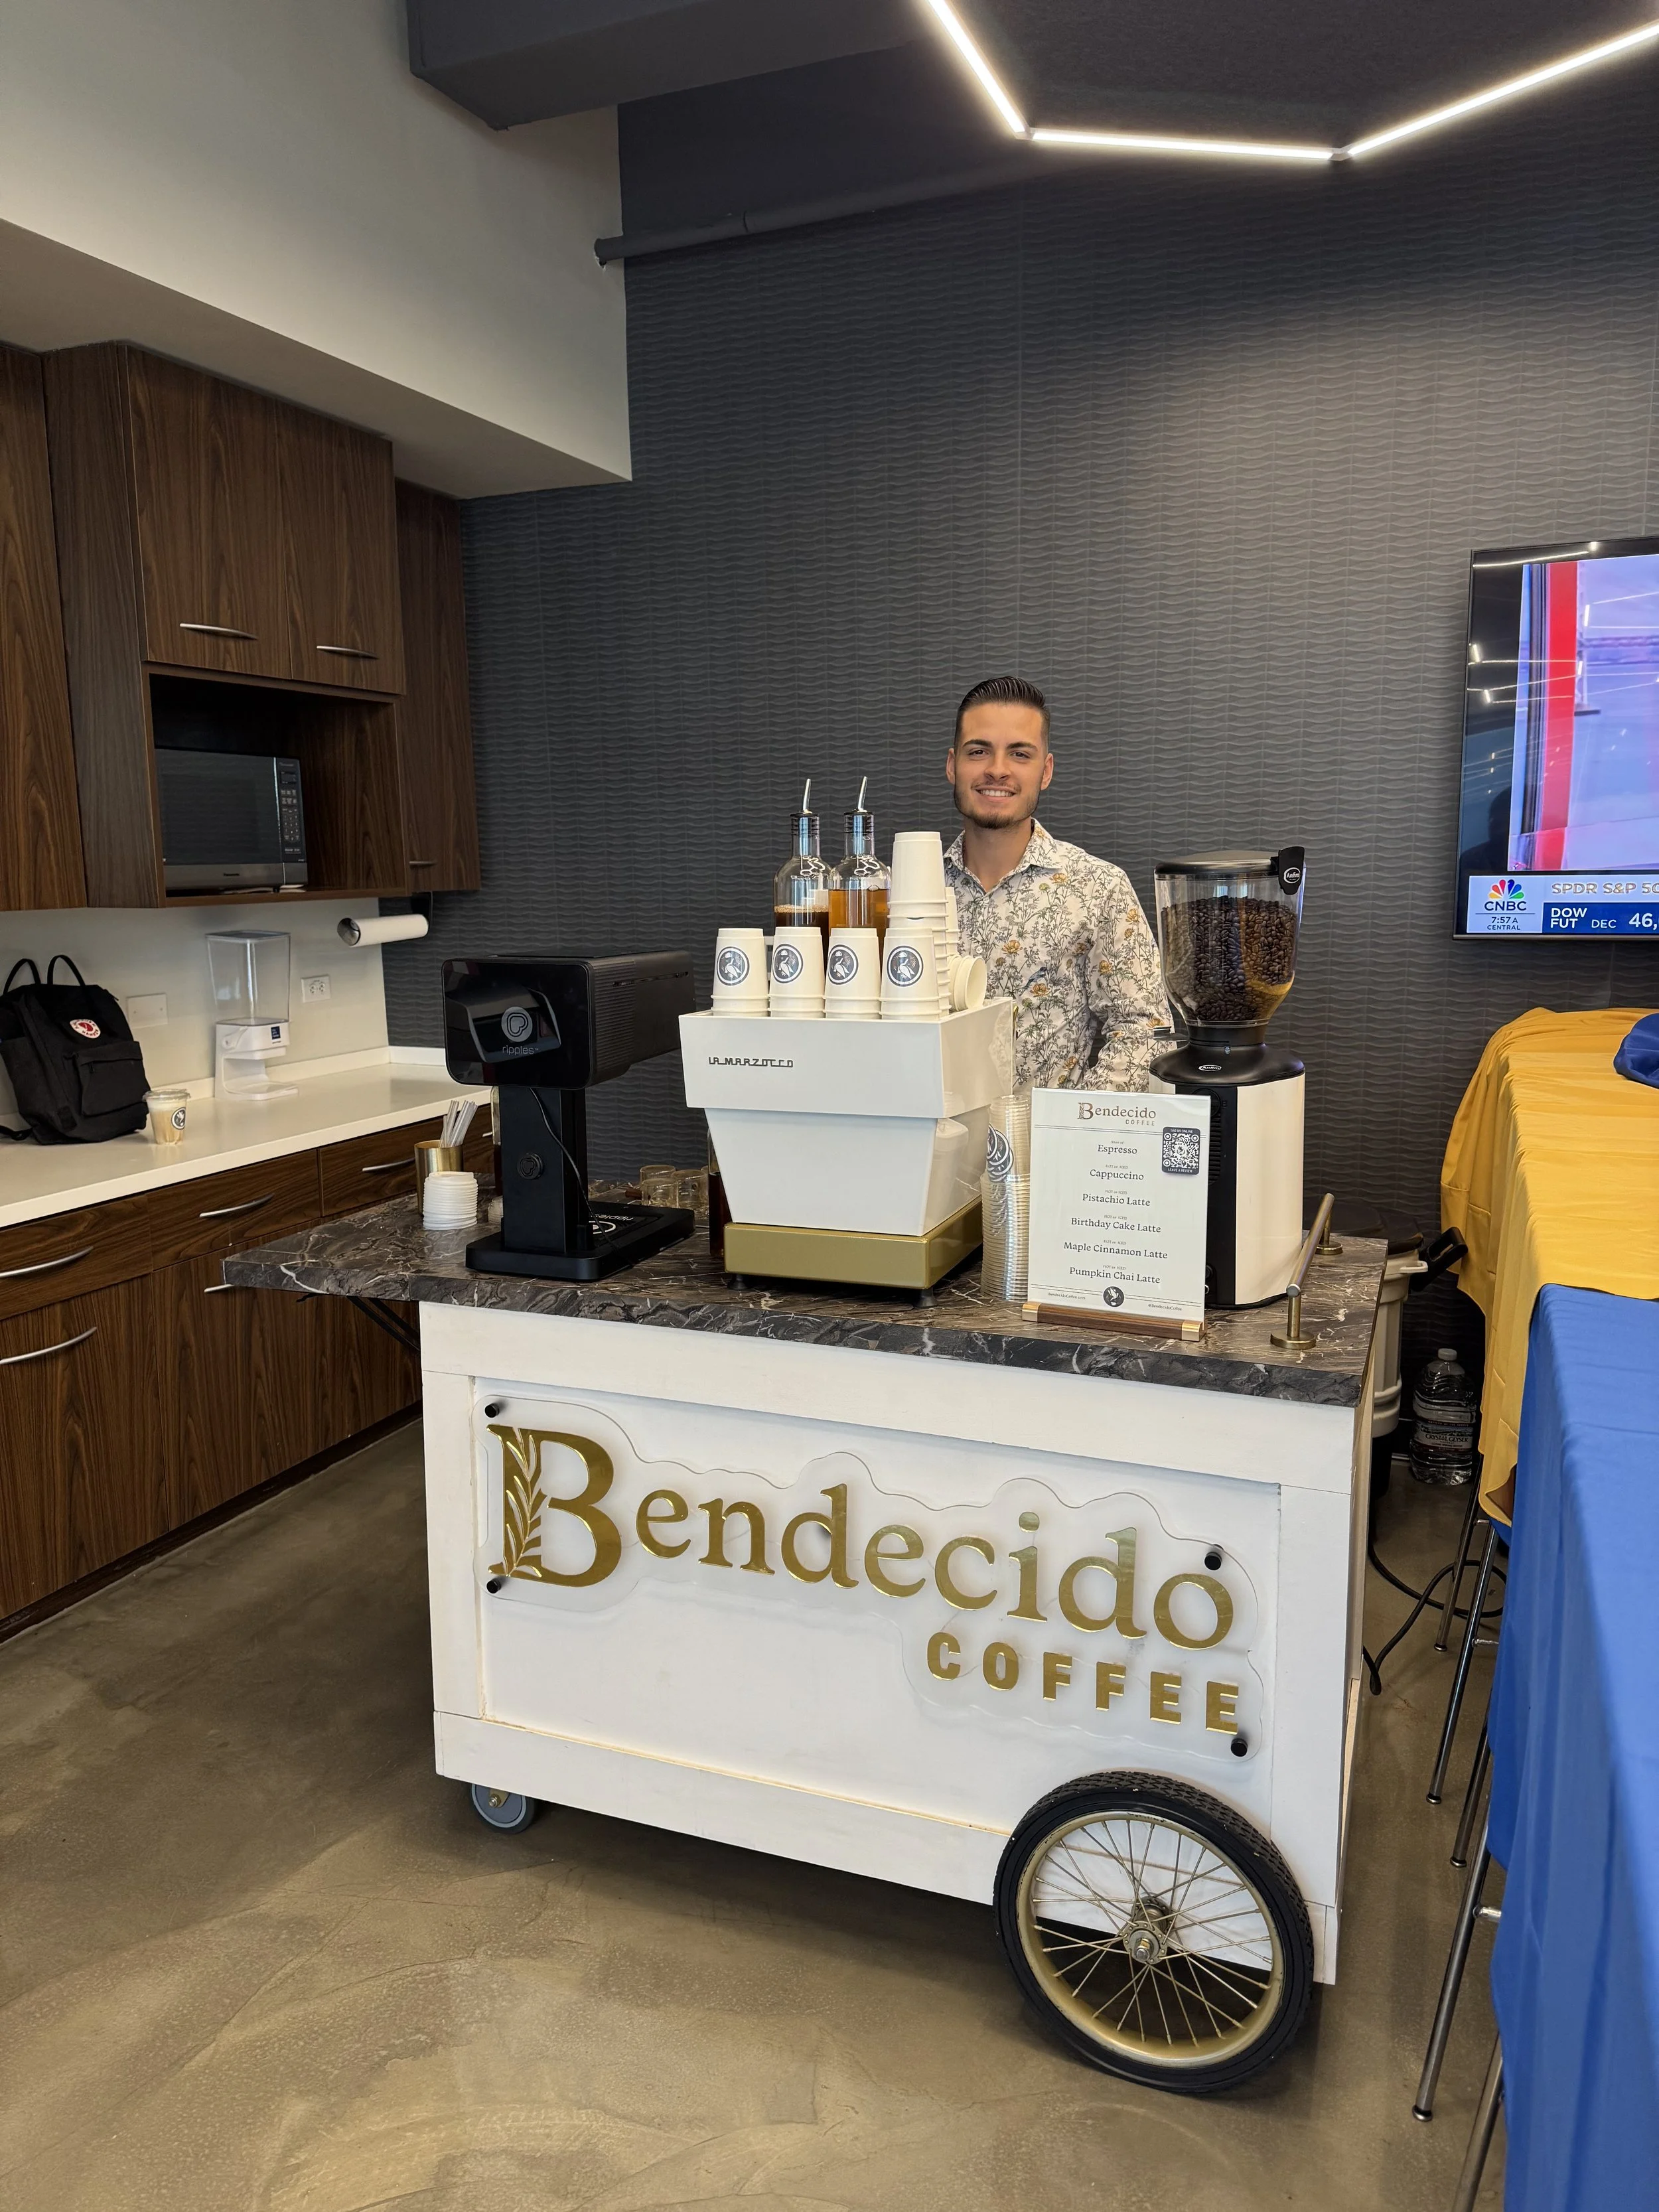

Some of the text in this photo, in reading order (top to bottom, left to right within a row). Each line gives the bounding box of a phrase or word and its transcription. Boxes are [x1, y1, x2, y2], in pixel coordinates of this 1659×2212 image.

[1551, 883, 1598, 894] SPDR
[1603, 883, 1636, 894] S&P
[1484, 901, 1527, 911] CNBC
[1551, 907, 1588, 918] DOW
[1550, 918, 1578, 928] FUT
[1591, 913, 1659, 930] DEC 46,
[502, 1045, 535, 1056] ripples
[1077, 1102, 1157, 1120] Bendecido
[1098, 1144, 1137, 1155] Espresso
[1090, 1169, 1144, 1181] Cappuccino
[1082, 1193, 1151, 1207] Pistachio Latte
[1070, 1217, 1161, 1233] Birthday Cake Latte
[1063, 1242, 1168, 1259] Maple Cinnamon Latte
[1069, 1267, 1161, 1284] Pumpkin Chai Latte
[487, 1424, 1235, 1651] Bendecido
[927, 1632, 1240, 1734] COFFEE
